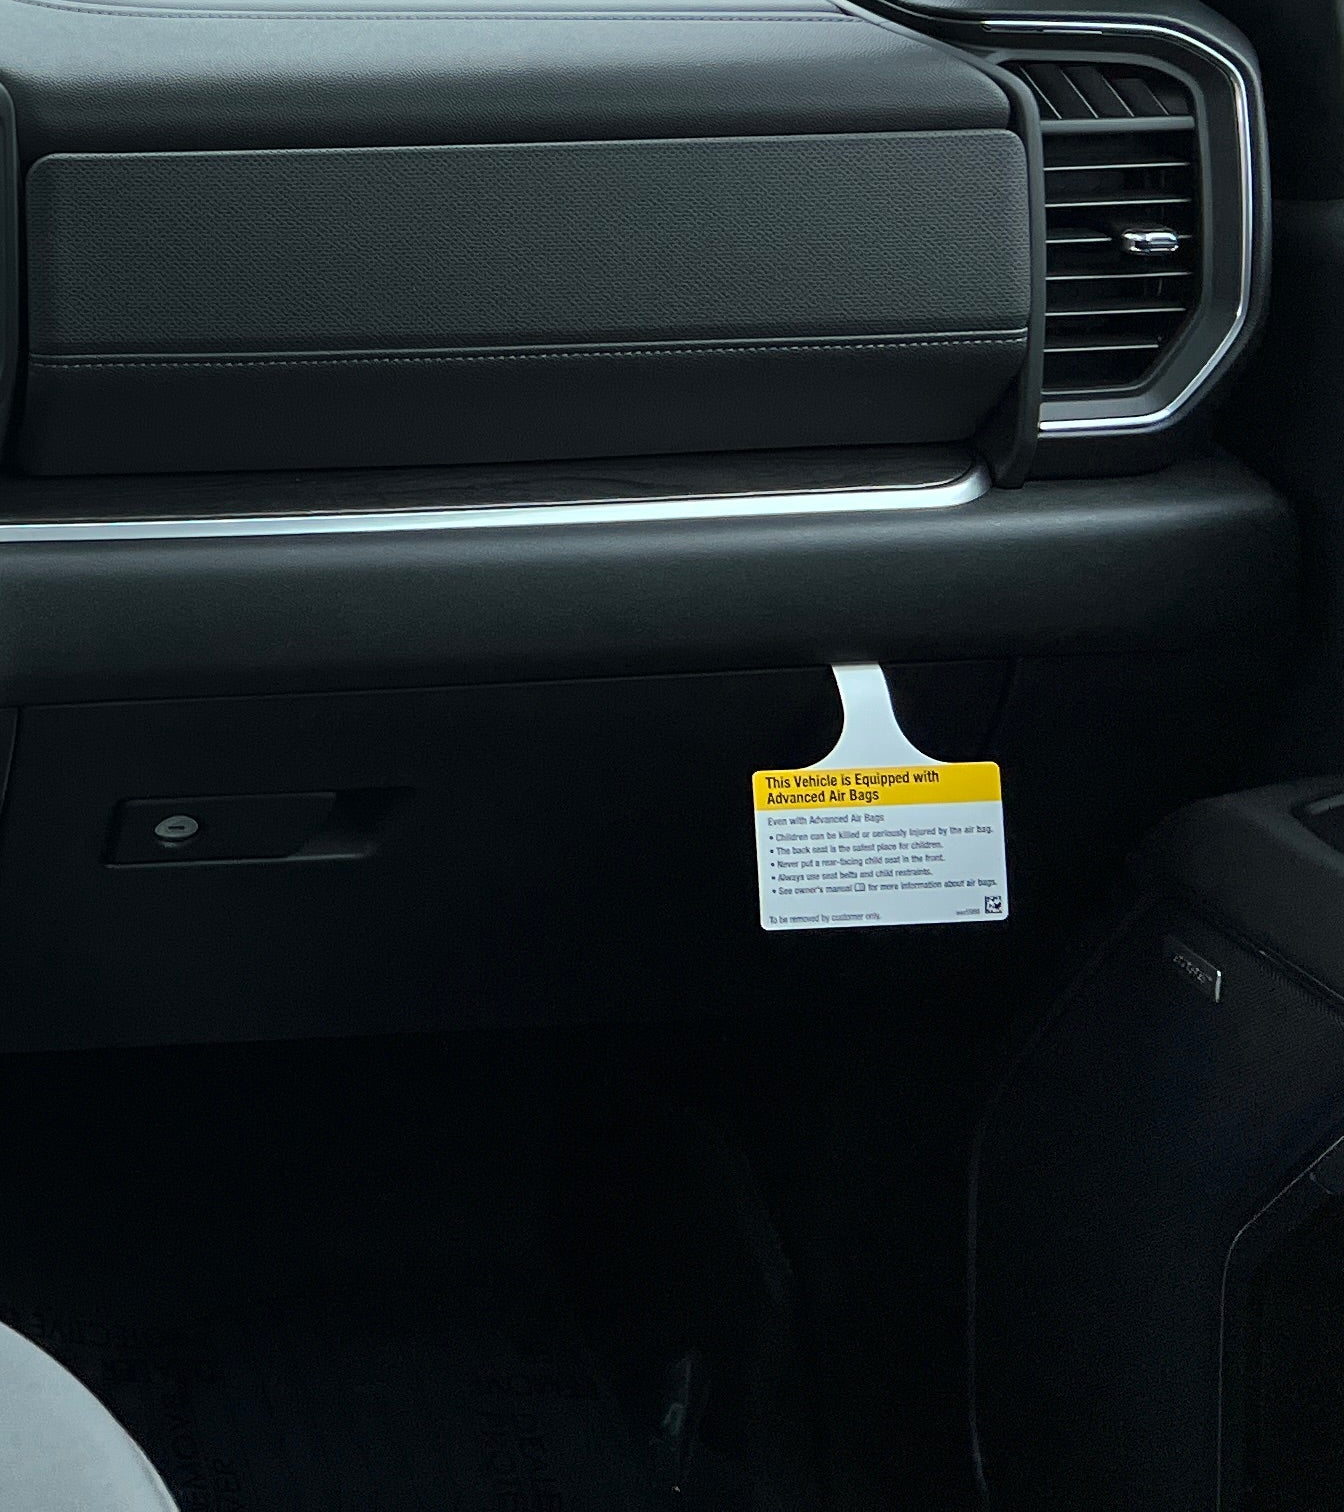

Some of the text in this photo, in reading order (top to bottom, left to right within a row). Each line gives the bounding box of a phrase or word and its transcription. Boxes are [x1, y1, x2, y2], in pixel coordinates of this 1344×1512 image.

[765, 770, 940, 789] This Vehicle is Equipped with
[767, 789, 880, 805] Advanced Air Bags
[767, 813, 885, 827] Even with Advanced Air Bags
[775, 832, 809, 842] Children
[810, 833, 824, 841] can
[827, 831, 837, 840] be
[838, 830, 860, 839] killed
[872, 828, 907, 838] seriously
[909, 827, 936, 837] injured
[938, 826, 947, 836] by
[949, 826, 962, 834] the
[964, 825, 974, 834] air
[776, 846, 791, 855] The
[792, 846, 810, 855] back
[812, 845, 828, 854] seat
[838, 844, 851, 853] the
[852, 843, 875, 852] safest
[876, 842, 897, 852] place
[898, 841, 909, 850] for
[911, 841, 944, 850] children.
[777, 860, 799, 869] Never
[801, 859, 814, 869] put
[821, 858, 863, 867] rear-facing
[864, 856, 883, 865] child
[884, 856, 901, 864] seat
[902, 855, 910, 863] in
[911, 855, 923, 863] the
[925, 854, 945, 862] front.
[778, 868, 933, 883] Always use seat belts and child restraints.
[778, 878, 998, 895] See owner's manual for more information about air bags.
[769, 915, 778, 925] To
[779, 915, 788, 924] be
[790, 914, 820, 923] removed
[821, 914, 830, 923] by
[831, 912, 863, 922] customer
